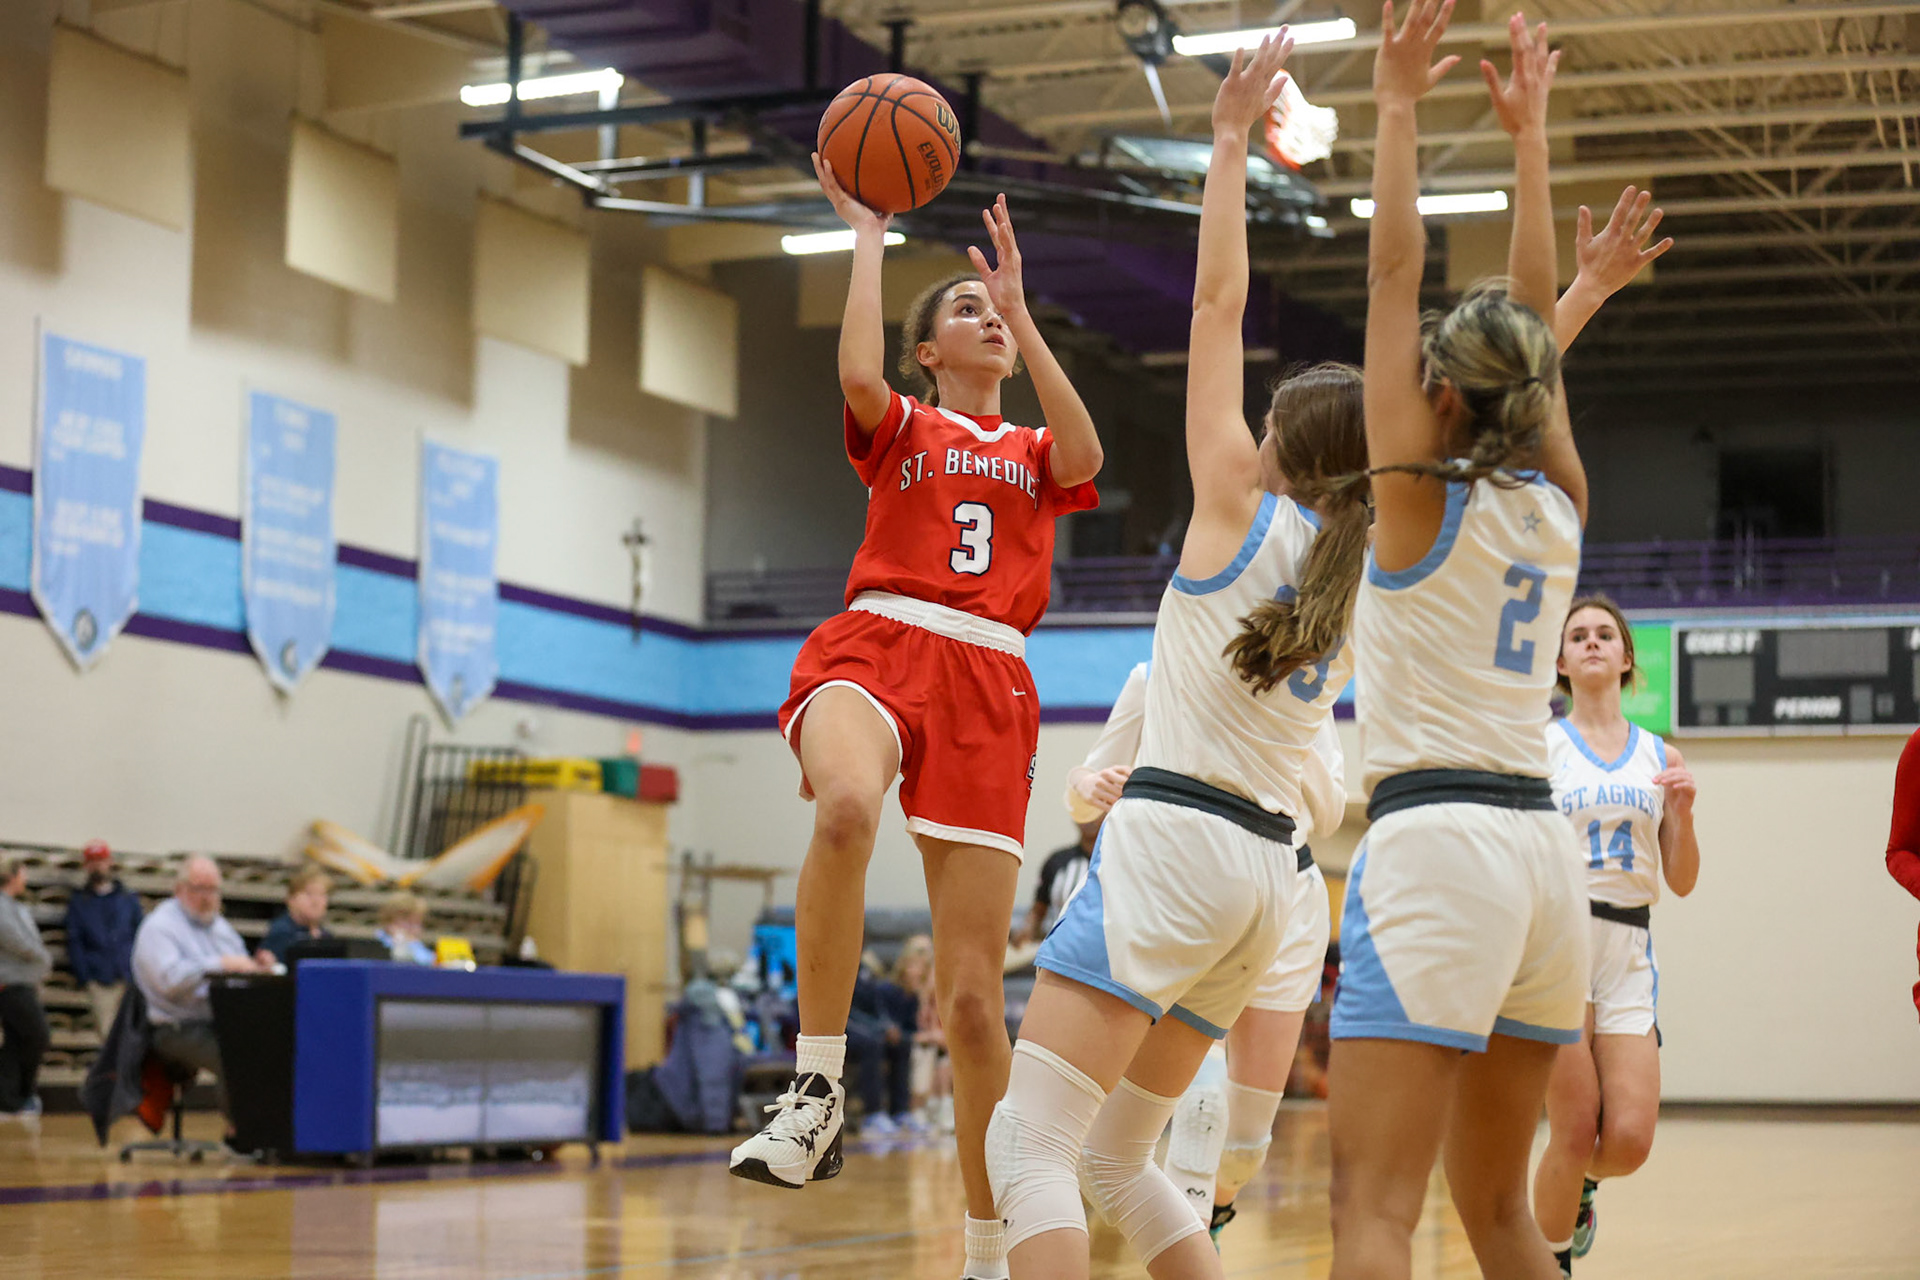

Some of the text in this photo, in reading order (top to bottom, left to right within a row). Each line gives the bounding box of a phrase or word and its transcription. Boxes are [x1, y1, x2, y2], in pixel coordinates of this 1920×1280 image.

[900, 450, 934, 491] ST.
[948, 500, 994, 577] 3
[1493, 562, 1547, 675] 2
[1561, 787, 1589, 816] ST.
[1587, 819, 1635, 872] 14
